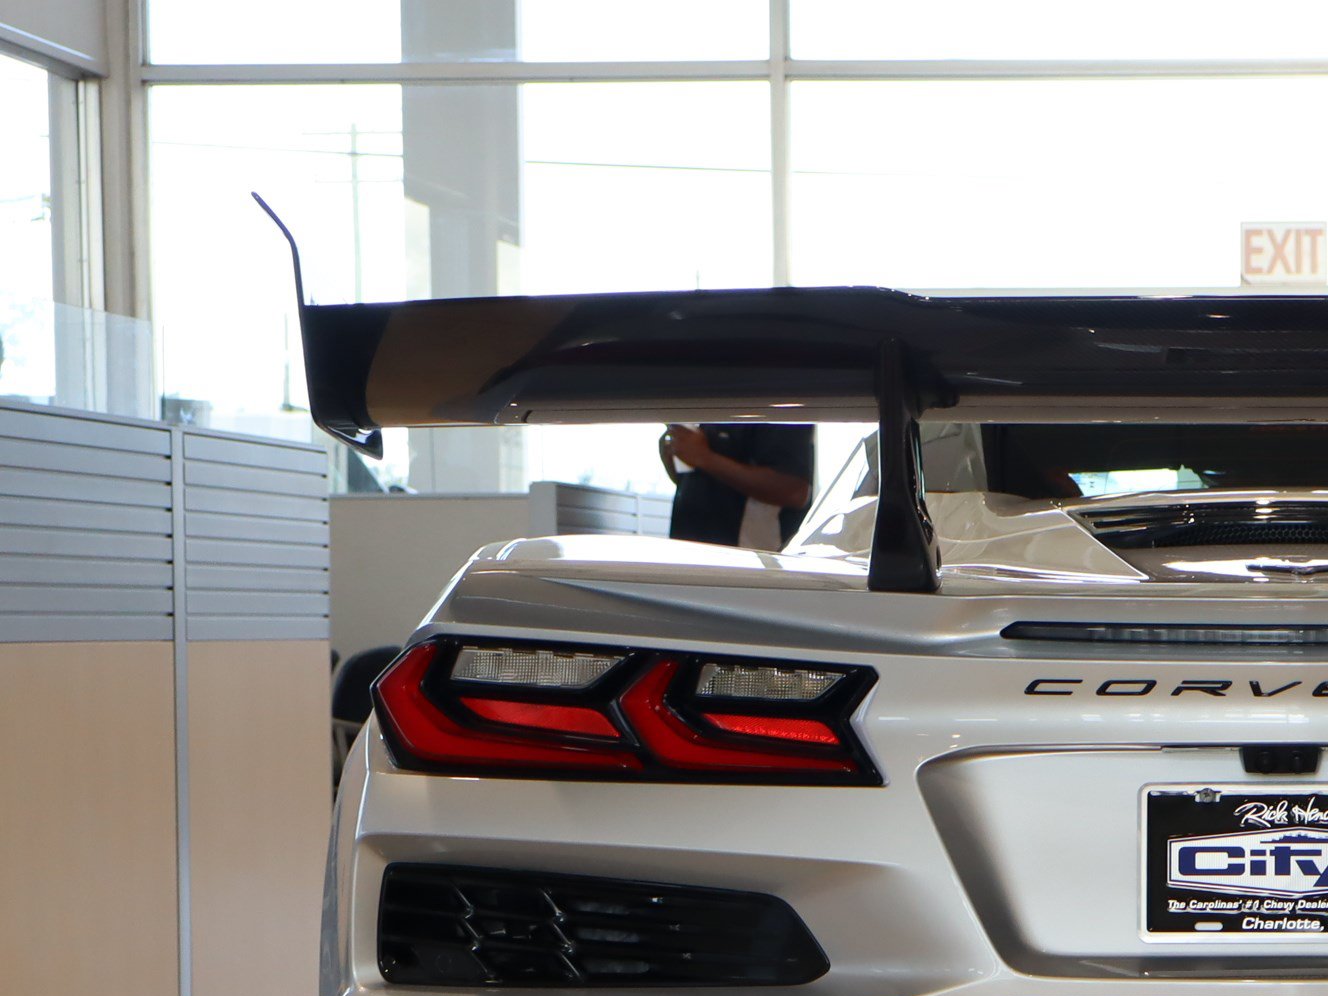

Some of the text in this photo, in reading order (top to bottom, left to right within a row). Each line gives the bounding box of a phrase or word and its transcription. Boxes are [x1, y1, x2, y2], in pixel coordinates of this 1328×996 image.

[1244, 228, 1325, 274] EXIT
[1233, 800, 1288, 828] Rick
[1167, 899, 1186, 909] The
[1245, 899, 1260, 909] #1
[1263, 899, 1295, 911] Chevy
[1242, 917, 1325, 932] Charlotte,
